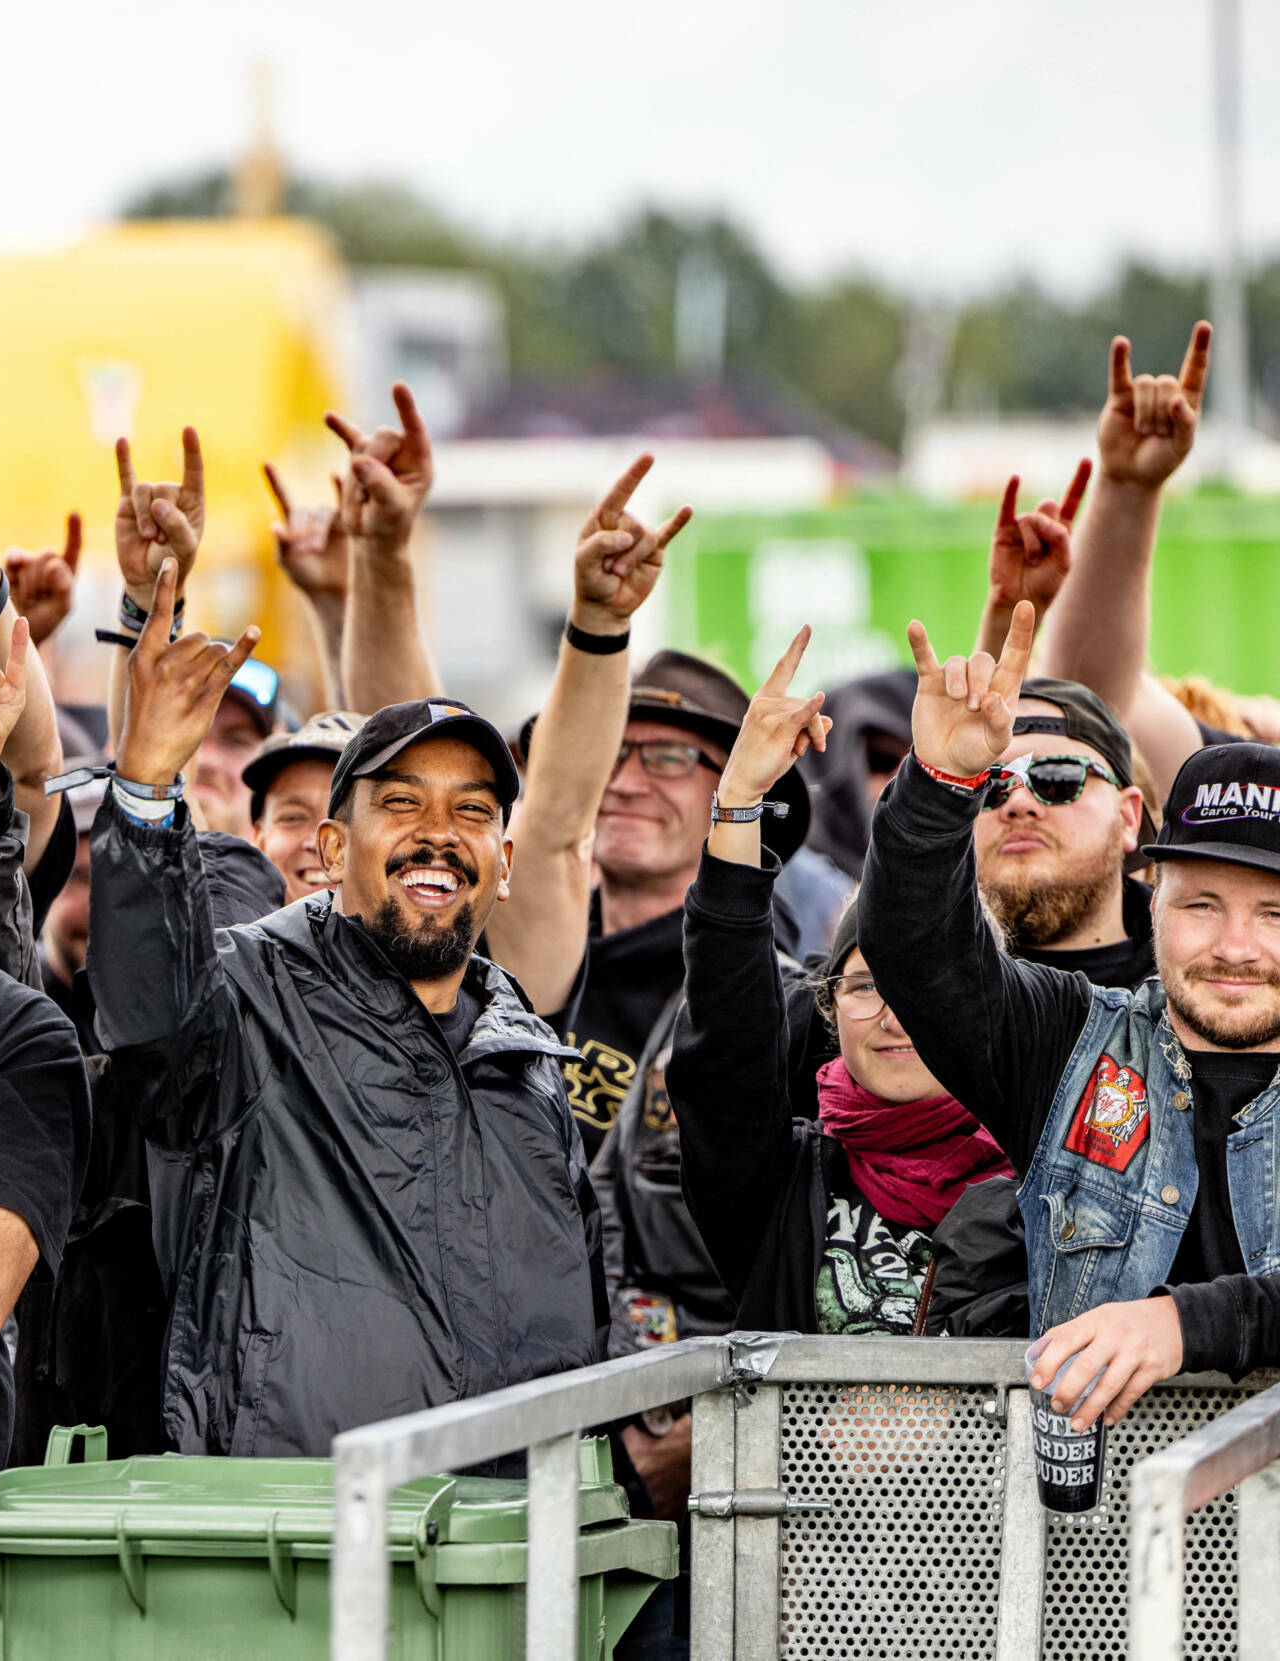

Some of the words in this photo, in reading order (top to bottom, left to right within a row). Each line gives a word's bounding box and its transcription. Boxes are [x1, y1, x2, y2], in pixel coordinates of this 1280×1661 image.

[1200, 806, 1238, 817] Carve
[1242, 806, 1276, 821] Your
[1036, 1459, 1095, 1488] UDER
